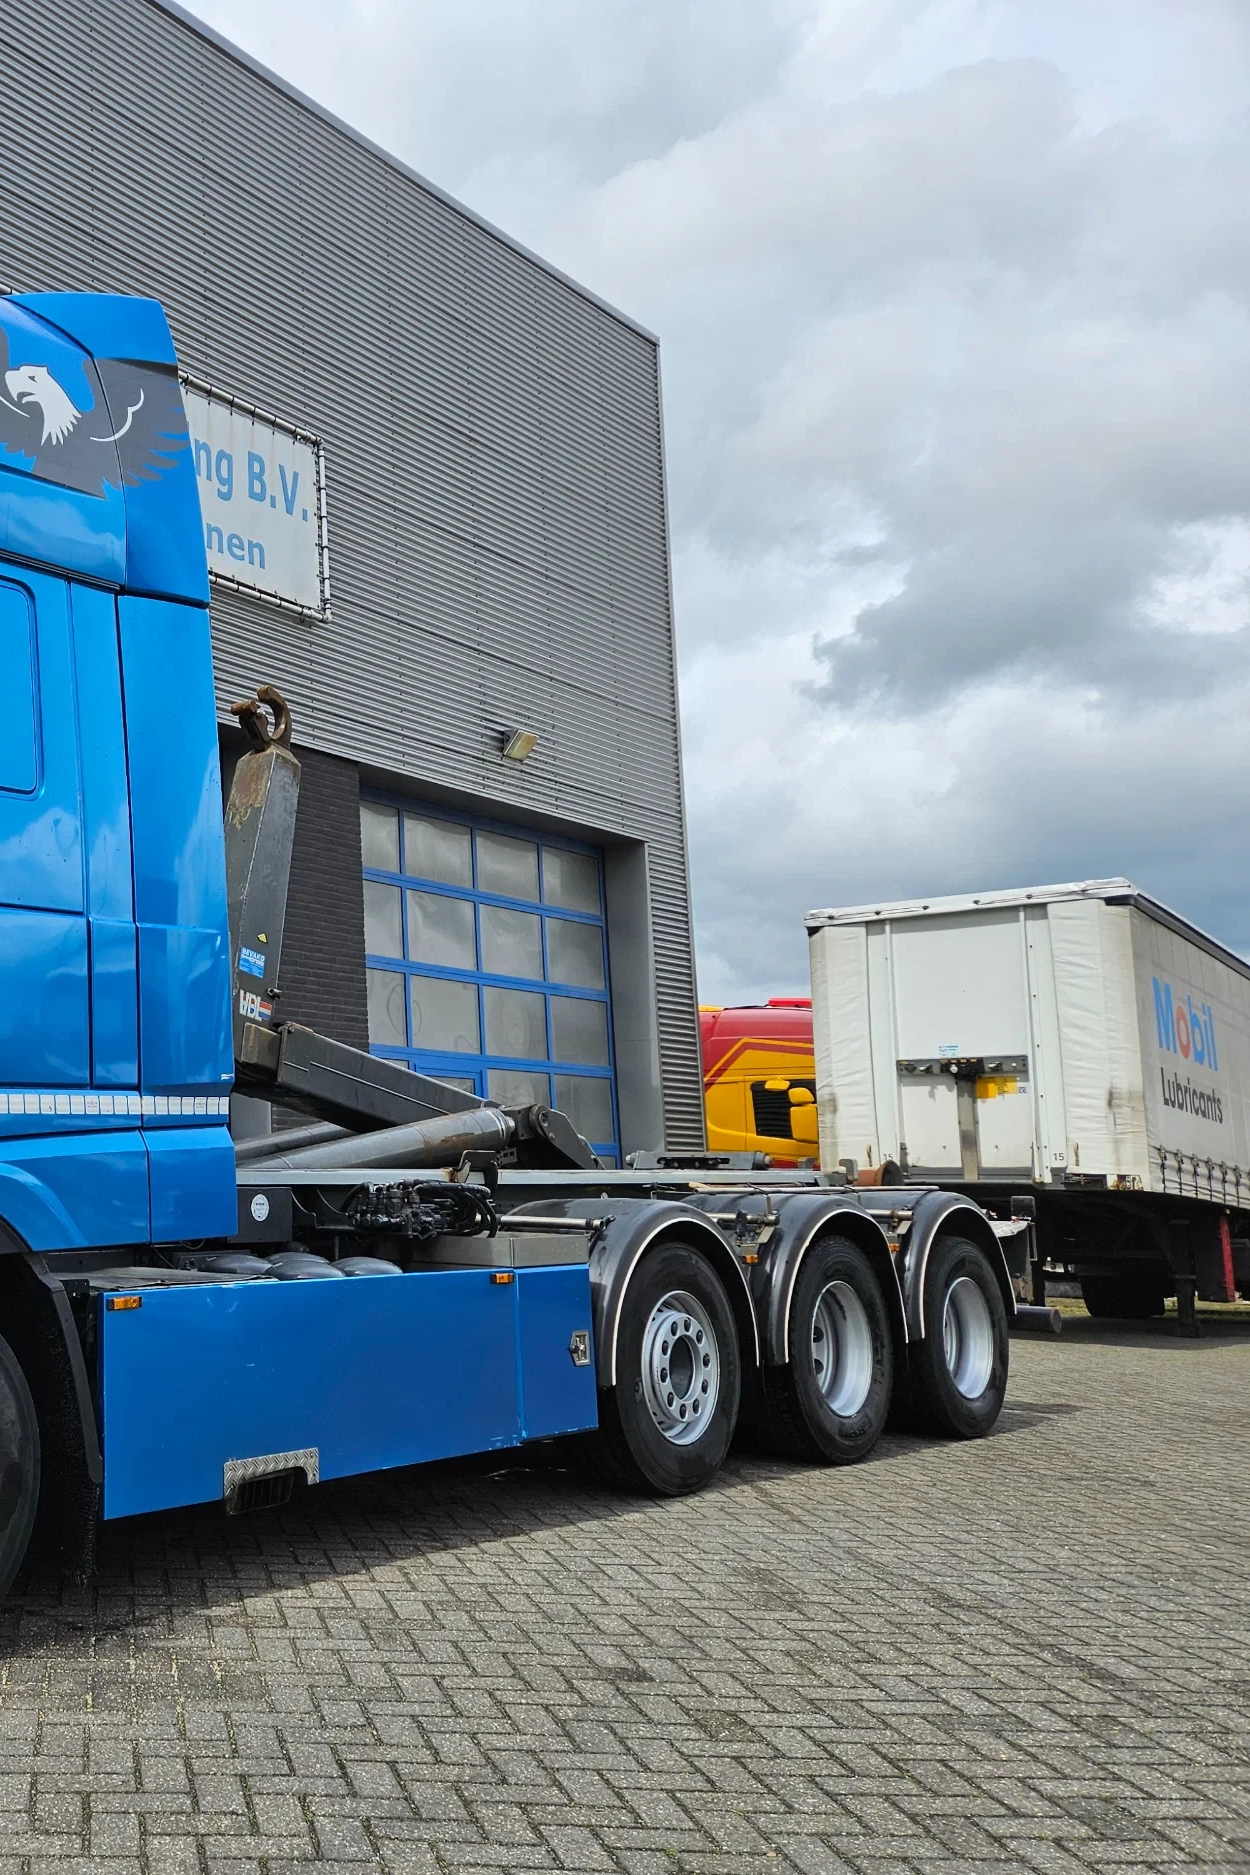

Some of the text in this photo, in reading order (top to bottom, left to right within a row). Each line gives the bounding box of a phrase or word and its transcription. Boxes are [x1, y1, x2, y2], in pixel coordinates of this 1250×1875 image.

[247, 450, 308, 522] B.V.
[241, 948, 265, 962] BEVAKO
[1152, 976, 1218, 1072] Mobil
[1160, 1067, 1223, 1124] Lubricants
[1052, 1152, 1065, 1161] 15
